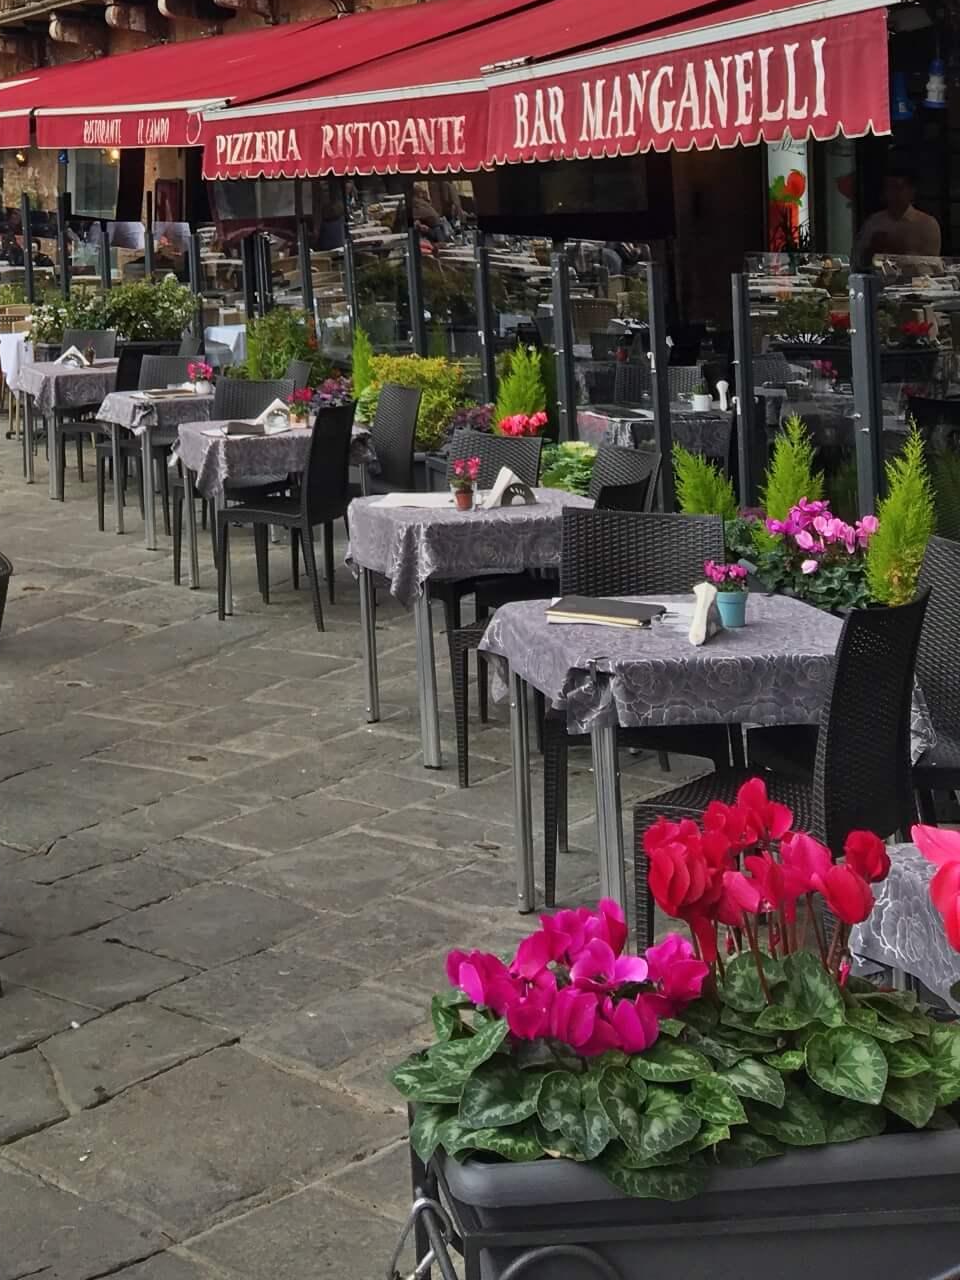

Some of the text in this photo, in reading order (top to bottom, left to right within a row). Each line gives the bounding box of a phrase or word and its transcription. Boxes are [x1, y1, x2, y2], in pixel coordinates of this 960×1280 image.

[513, 36, 828, 149] BAR MANGANELLI
[83, 118, 170, 144] RISTORANTE IL CAMPO
[215, 115, 466, 166] PIZZERIA RISTORANTE
